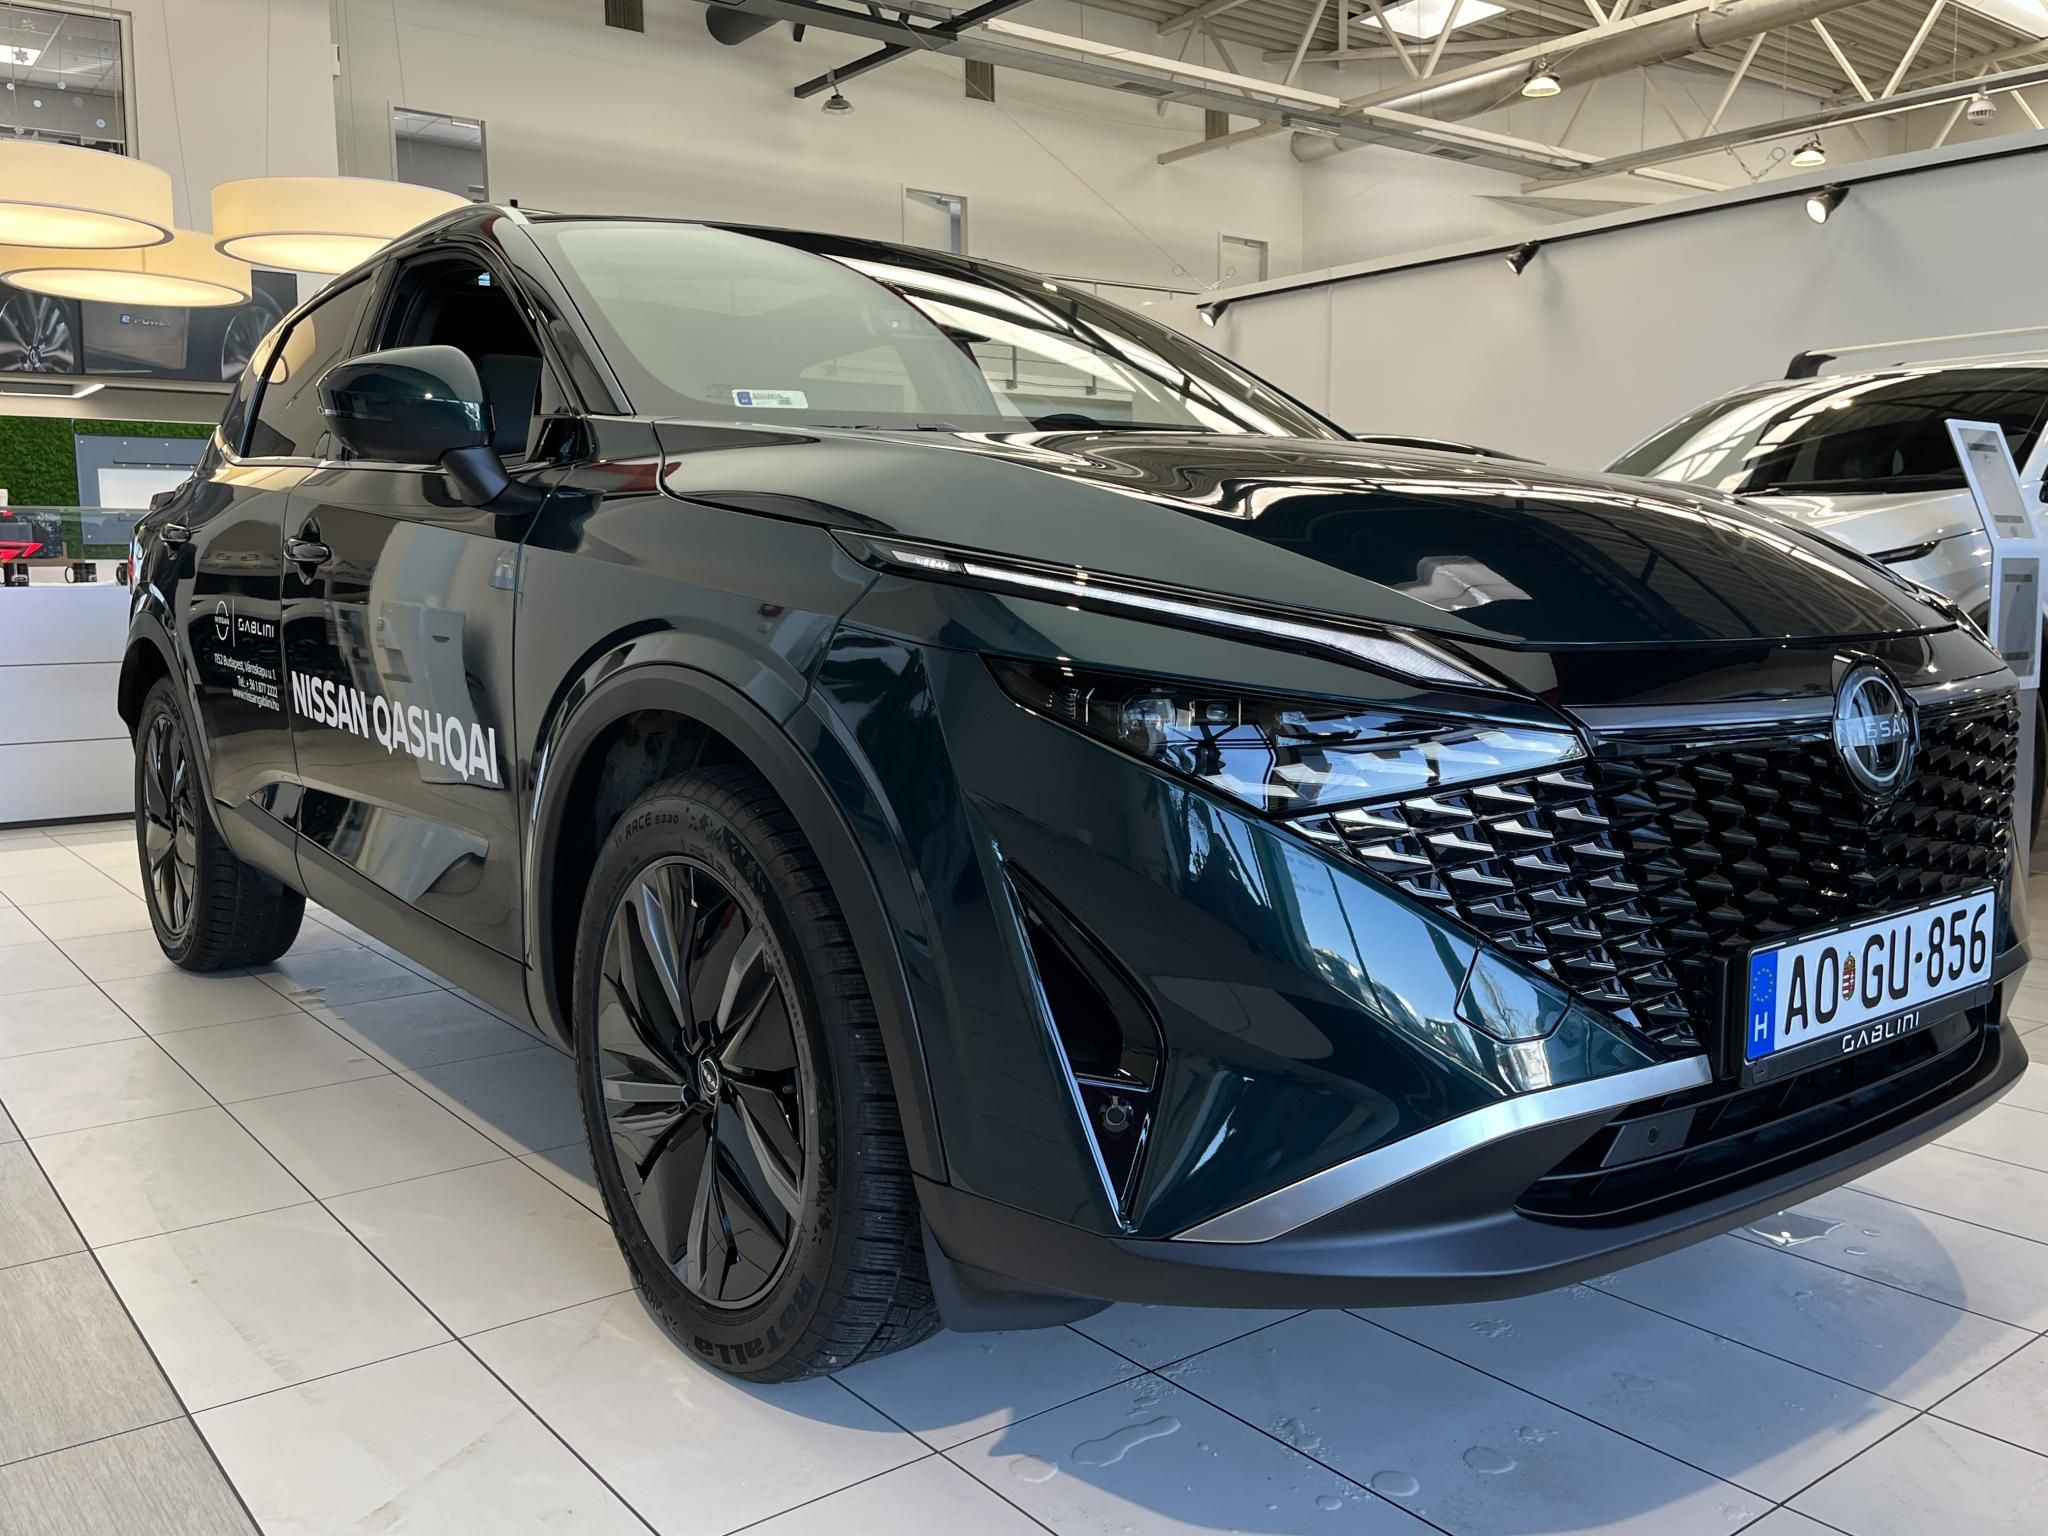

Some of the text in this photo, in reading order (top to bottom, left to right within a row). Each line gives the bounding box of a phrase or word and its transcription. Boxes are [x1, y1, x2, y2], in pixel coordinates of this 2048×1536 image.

[214, 615, 230, 626] NISSAN
[238, 618, 275, 638] GABLINI
[214, 653, 223, 665] 1152
[292, 670, 499, 784] NISSAN QASHQAI
[625, 811, 653, 841] RACE
[1754, 1011, 1768, 1042] H
[1842, 1011, 1920, 1054] GABLINI
